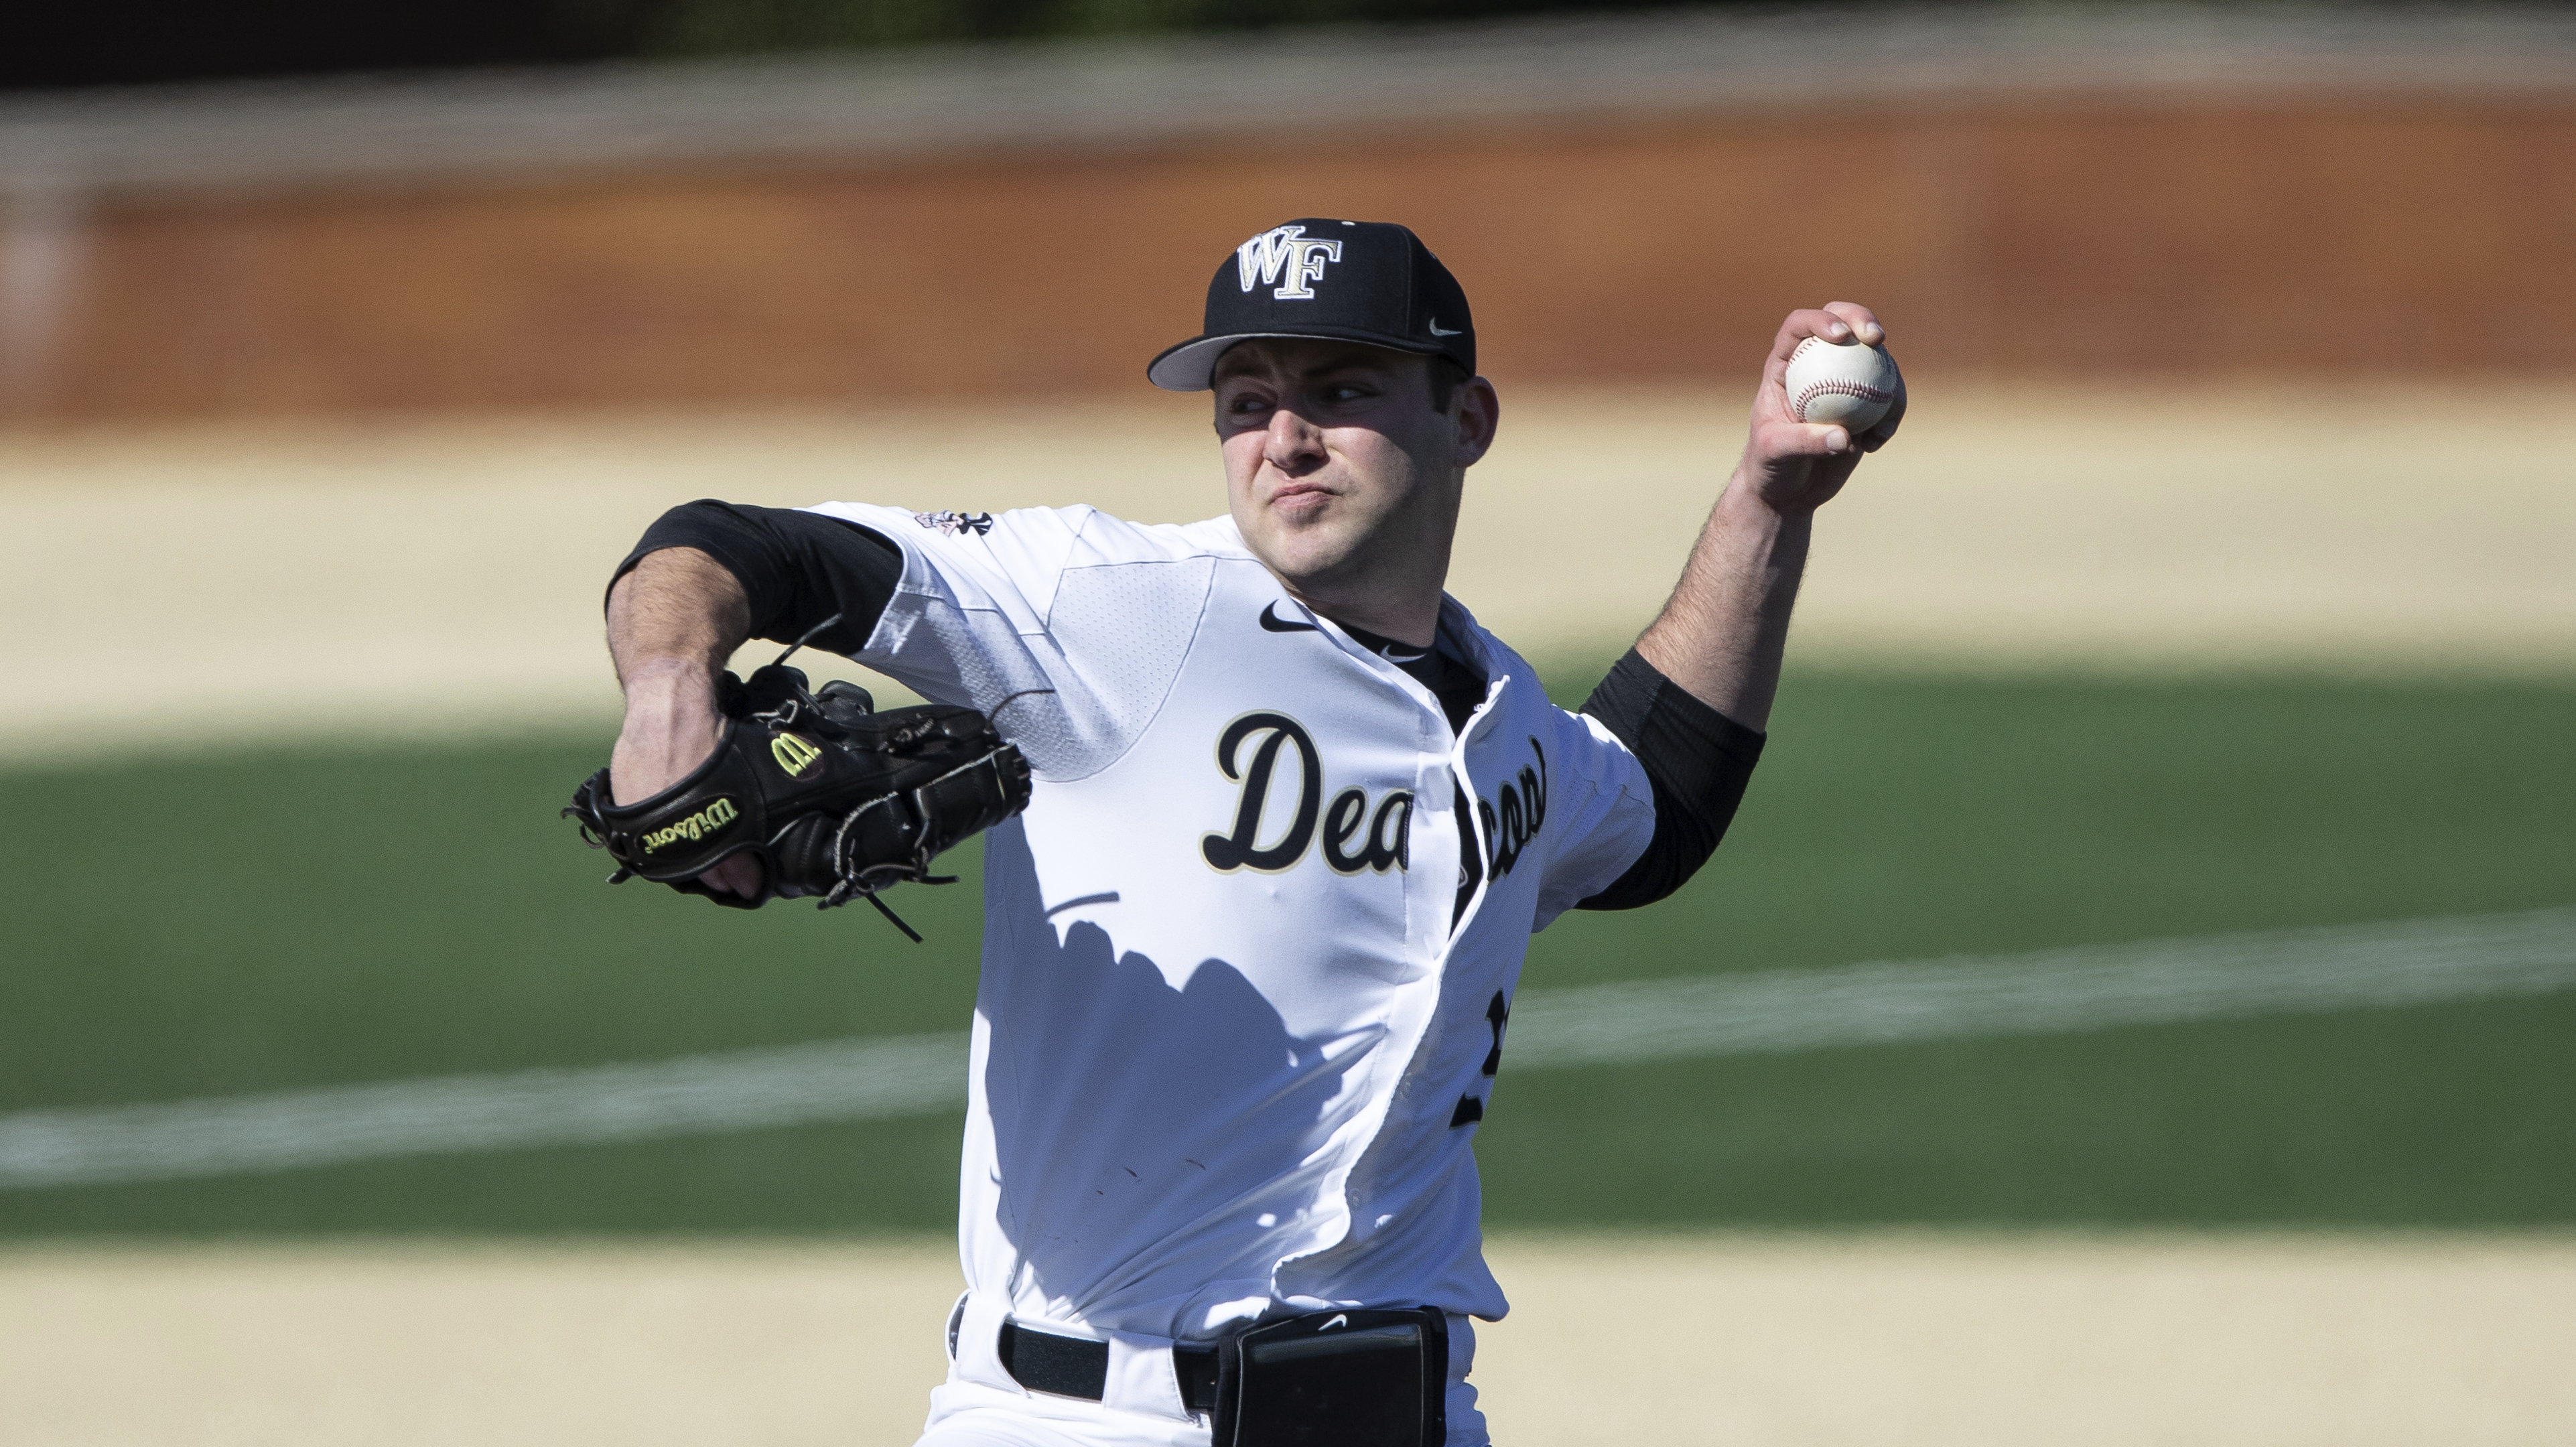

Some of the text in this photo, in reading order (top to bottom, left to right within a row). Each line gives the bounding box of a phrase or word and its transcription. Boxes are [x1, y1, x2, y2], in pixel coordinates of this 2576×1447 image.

[1237, 225, 1342, 299] WF
[642, 798, 738, 849] Wilson
[1199, 709, 1547, 886] Deacon
